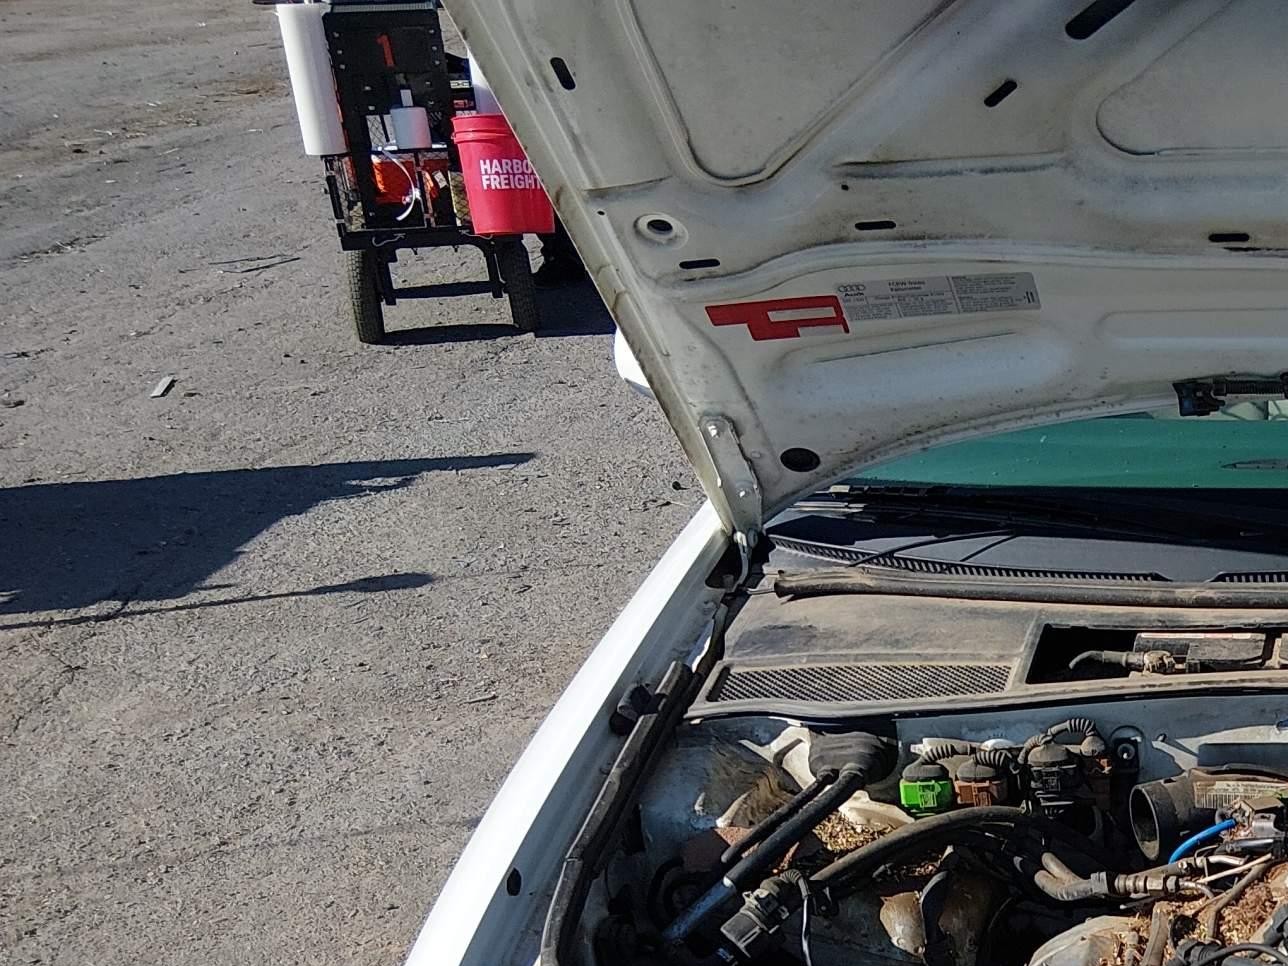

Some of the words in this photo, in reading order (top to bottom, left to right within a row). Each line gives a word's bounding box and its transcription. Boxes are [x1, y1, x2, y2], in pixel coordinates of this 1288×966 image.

[376, 33, 396, 68] 1
[479, 159, 534, 174] HARBO
[481, 175, 542, 190] FREIGHT
